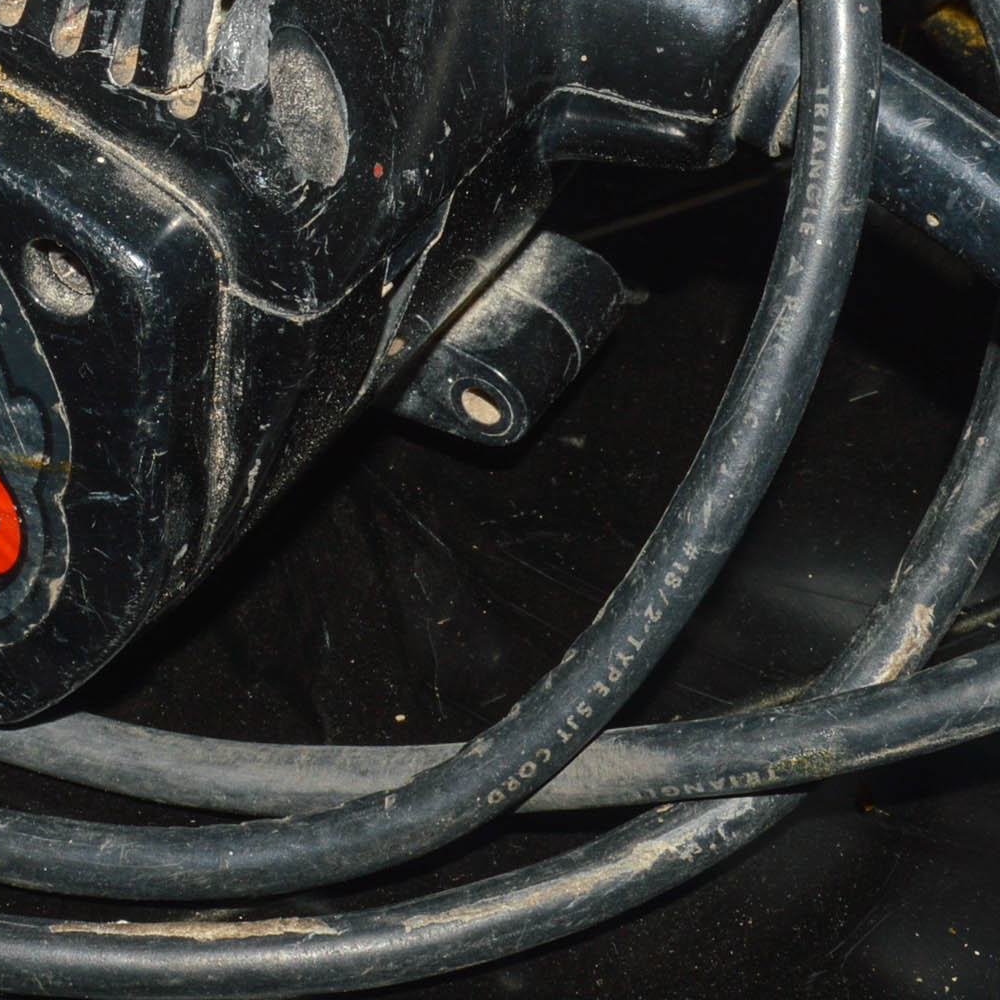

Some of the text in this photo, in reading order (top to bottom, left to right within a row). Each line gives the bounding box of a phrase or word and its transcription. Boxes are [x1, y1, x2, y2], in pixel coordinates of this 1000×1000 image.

[799, 86, 830, 236] TRIANGLE
[587, 635, 645, 698] TYPE
[557, 701, 593, 744] SJT
[487, 748, 551, 805] CORD
